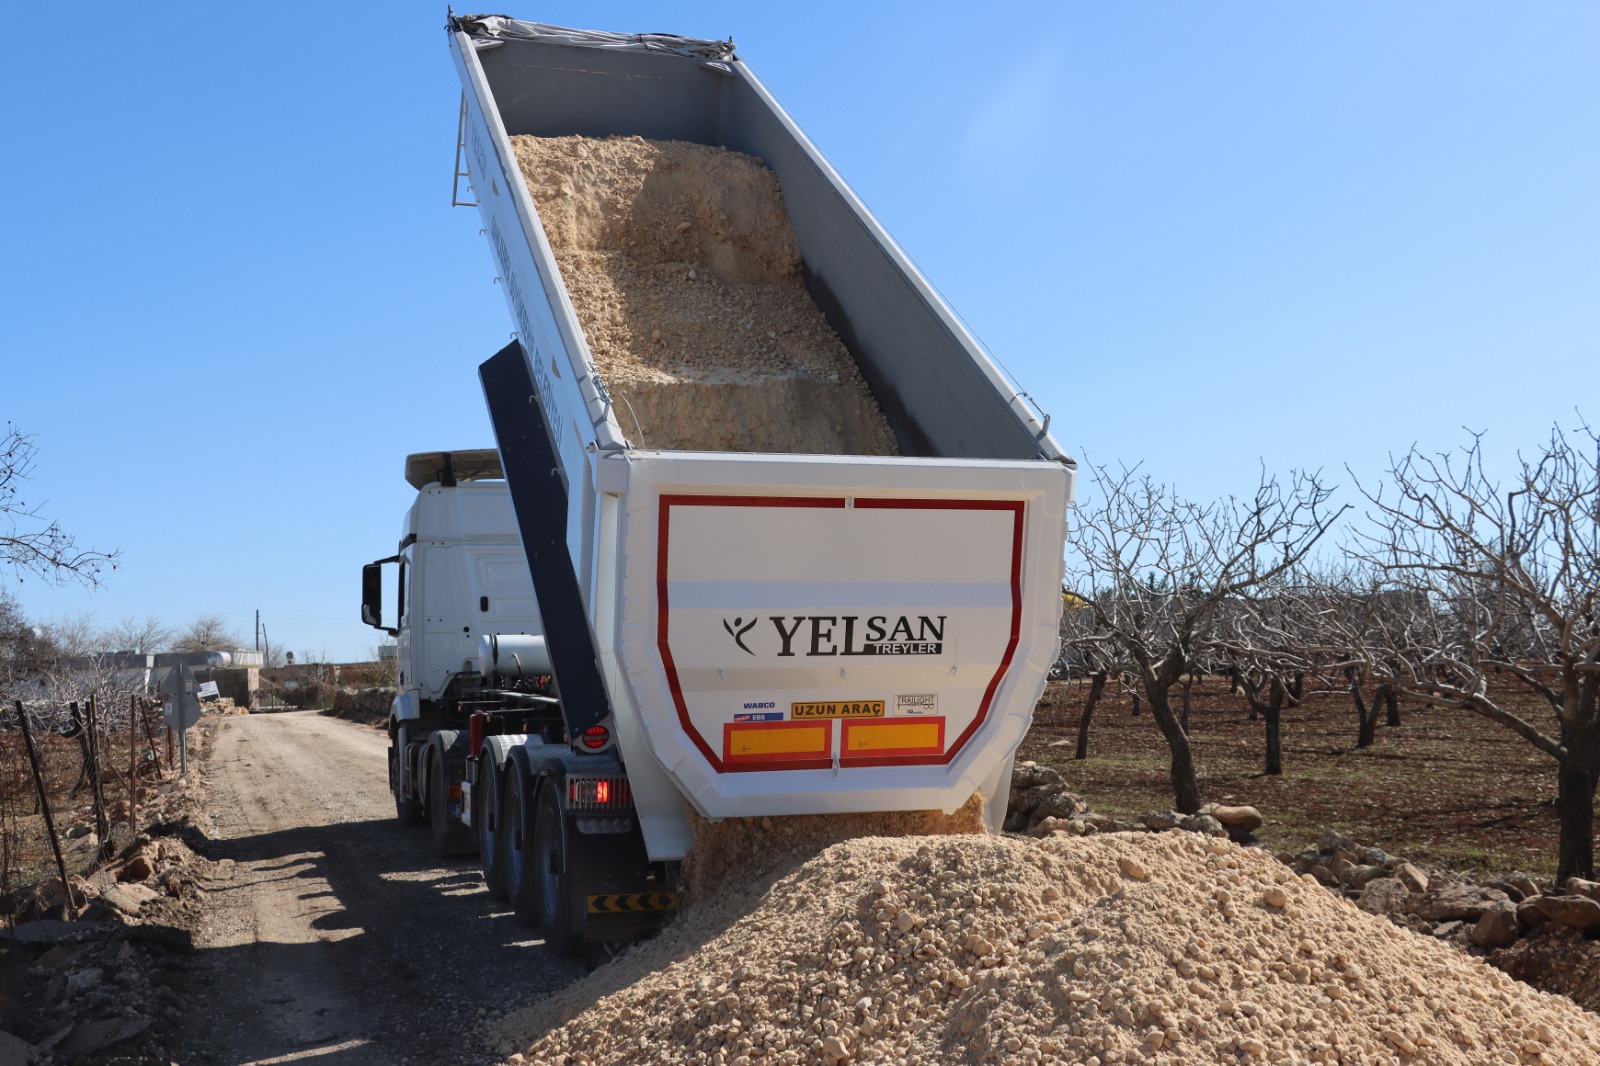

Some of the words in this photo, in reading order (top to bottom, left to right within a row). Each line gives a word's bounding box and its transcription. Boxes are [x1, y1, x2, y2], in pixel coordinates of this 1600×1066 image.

[769, 615, 947, 656] YELSAN
[873, 643, 937, 654] TREYLER
[795, 704, 836, 716] UZUN
[841, 703, 881, 716] ARAÇ
